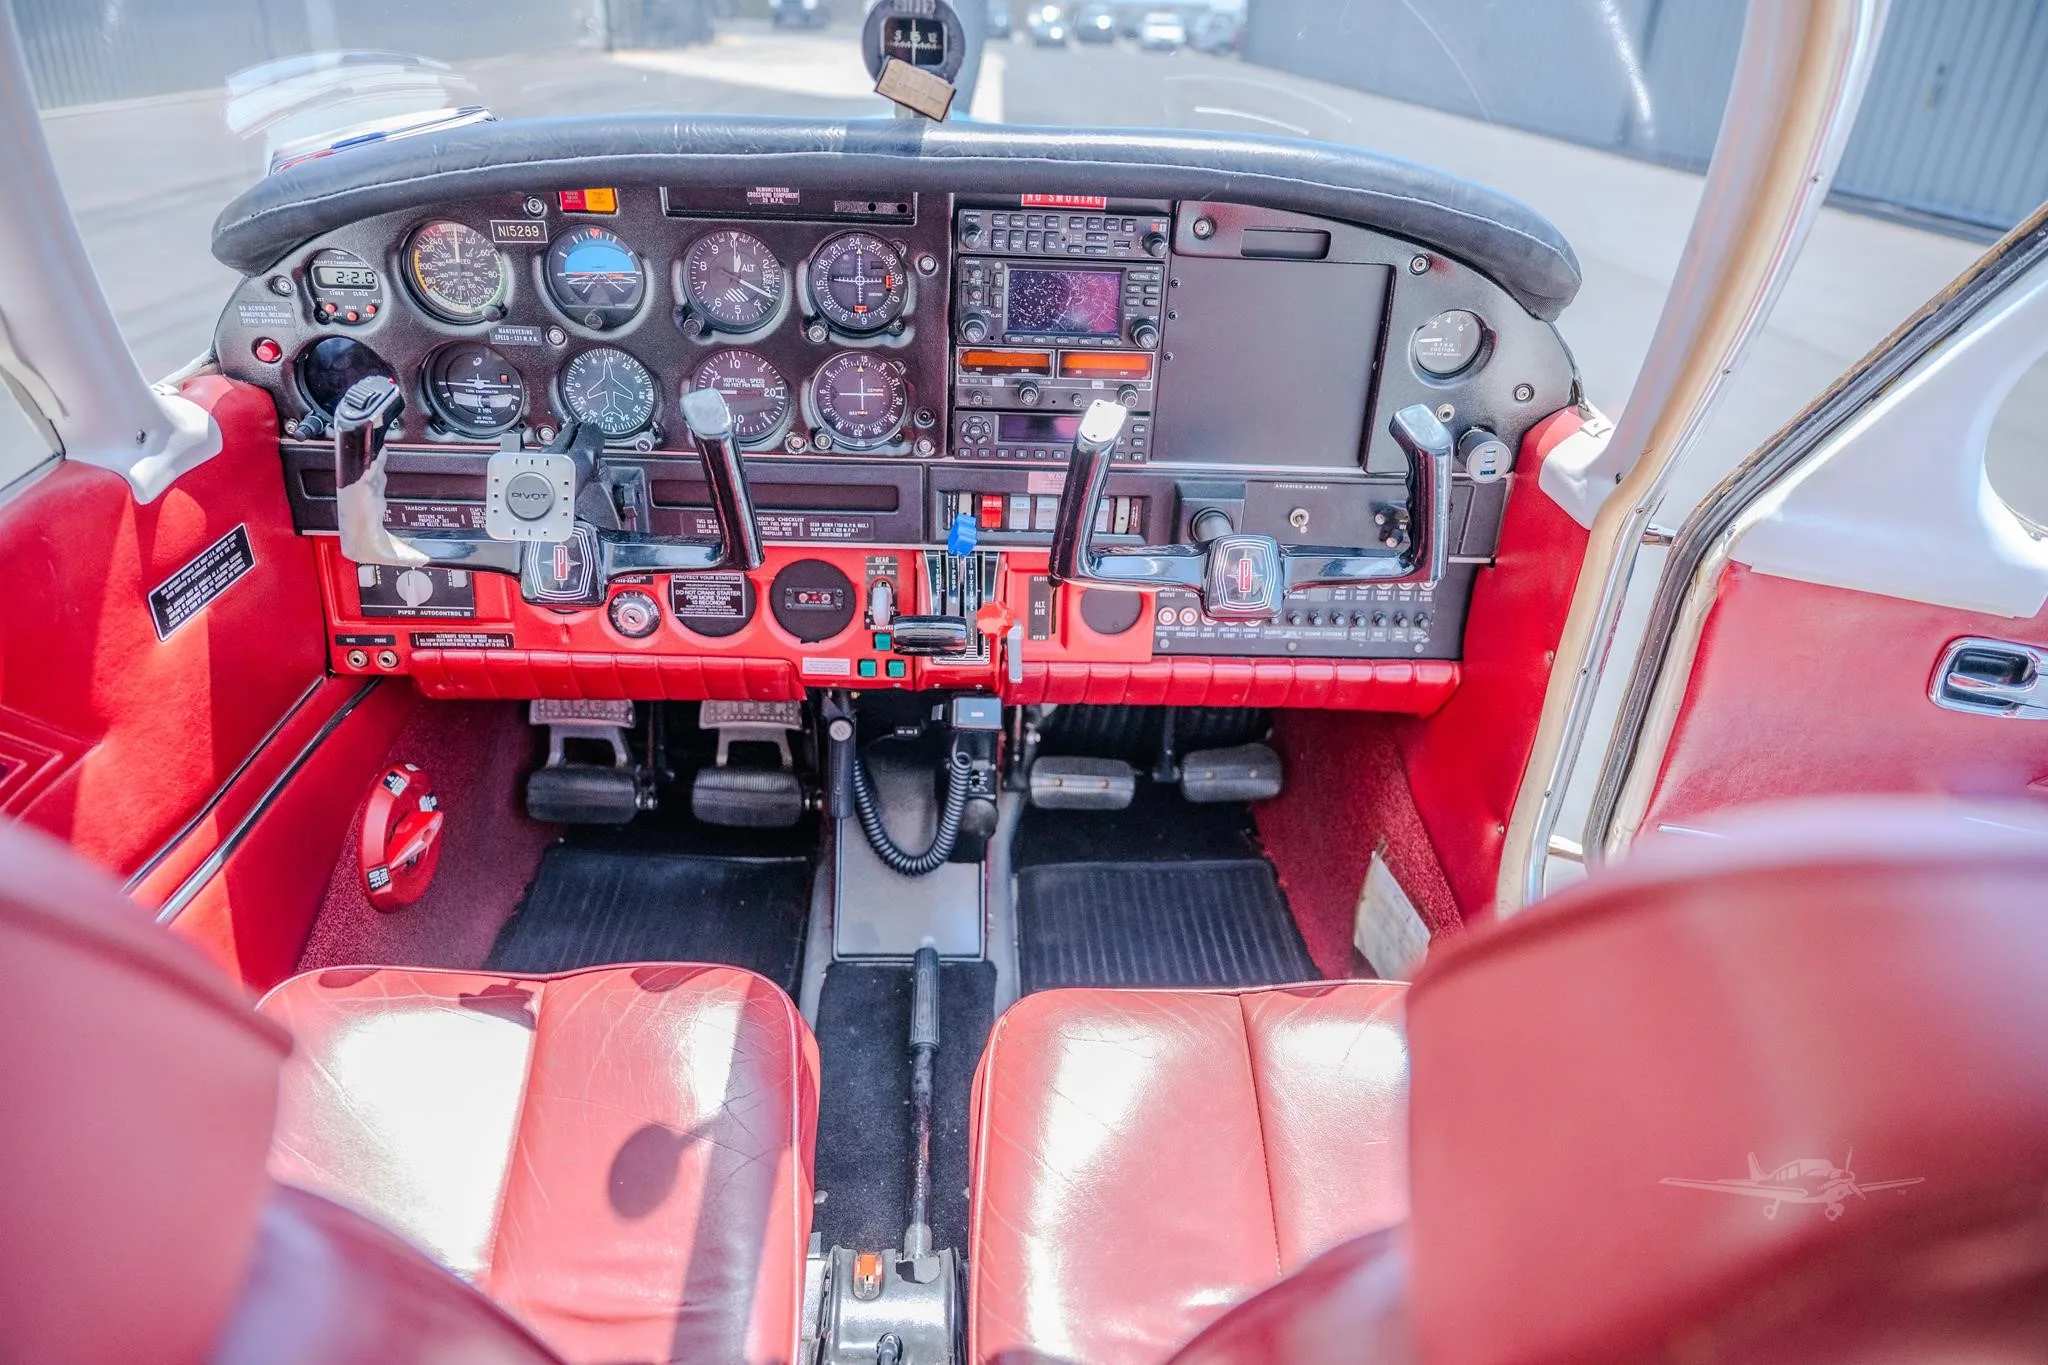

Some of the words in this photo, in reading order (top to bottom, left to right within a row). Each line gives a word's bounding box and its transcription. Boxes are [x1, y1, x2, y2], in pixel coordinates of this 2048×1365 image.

[1048, 194, 1101, 204] SMOKING
[742, 264, 755, 272] ALT
[511, 492, 548, 500] PIVOT
[1034, 608, 1045, 616] AIR
[369, 870, 382, 888] OFF
[380, 868, 389, 885] FUEL
